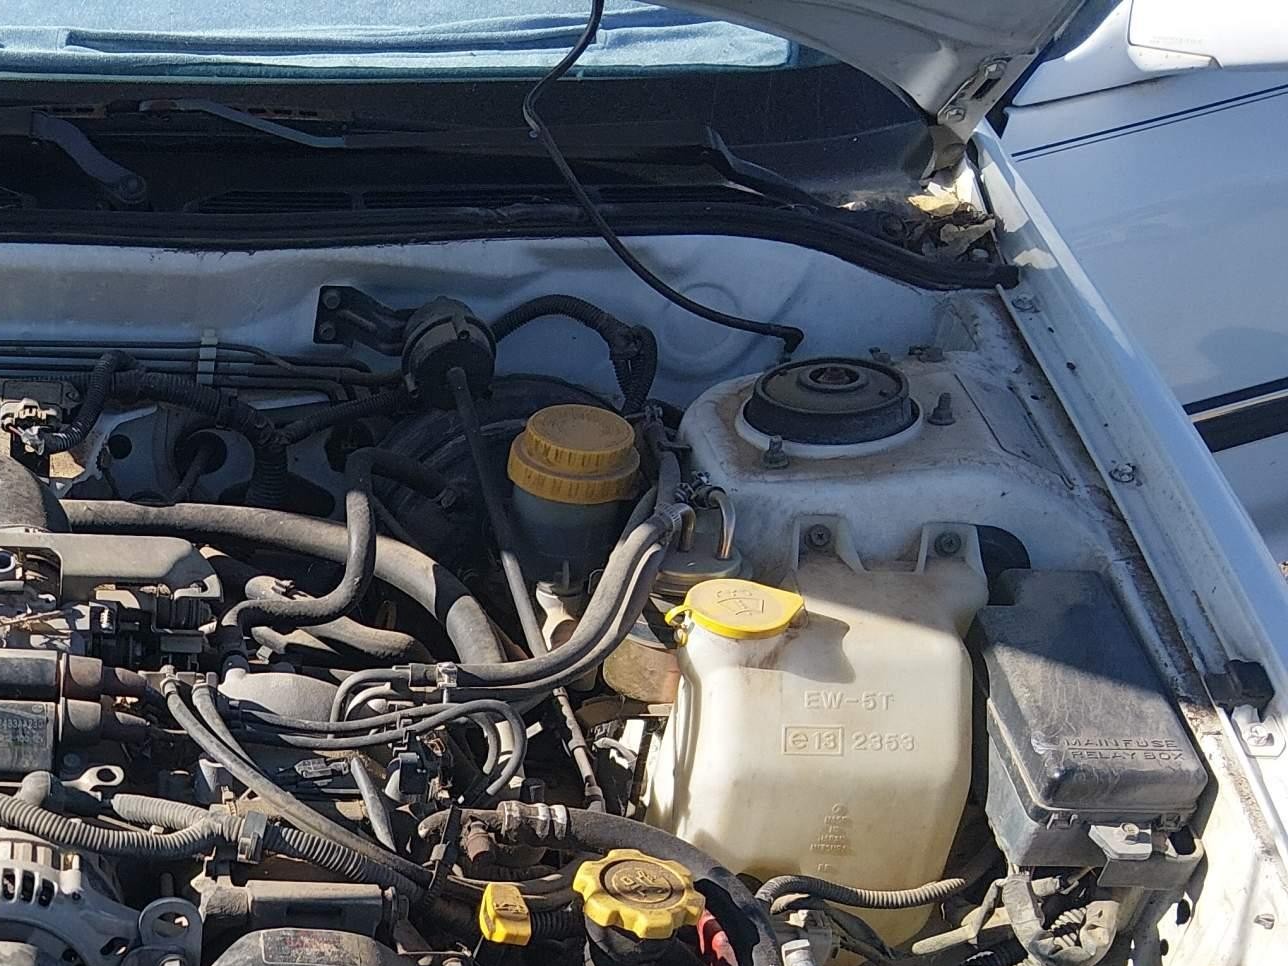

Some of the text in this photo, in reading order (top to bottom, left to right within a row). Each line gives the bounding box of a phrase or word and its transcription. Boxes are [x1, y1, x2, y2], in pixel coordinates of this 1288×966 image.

[803, 690, 895, 711] EW-5T
[852, 731, 916, 752] 2353
[1071, 751, 1185, 761] RELAY BOX
